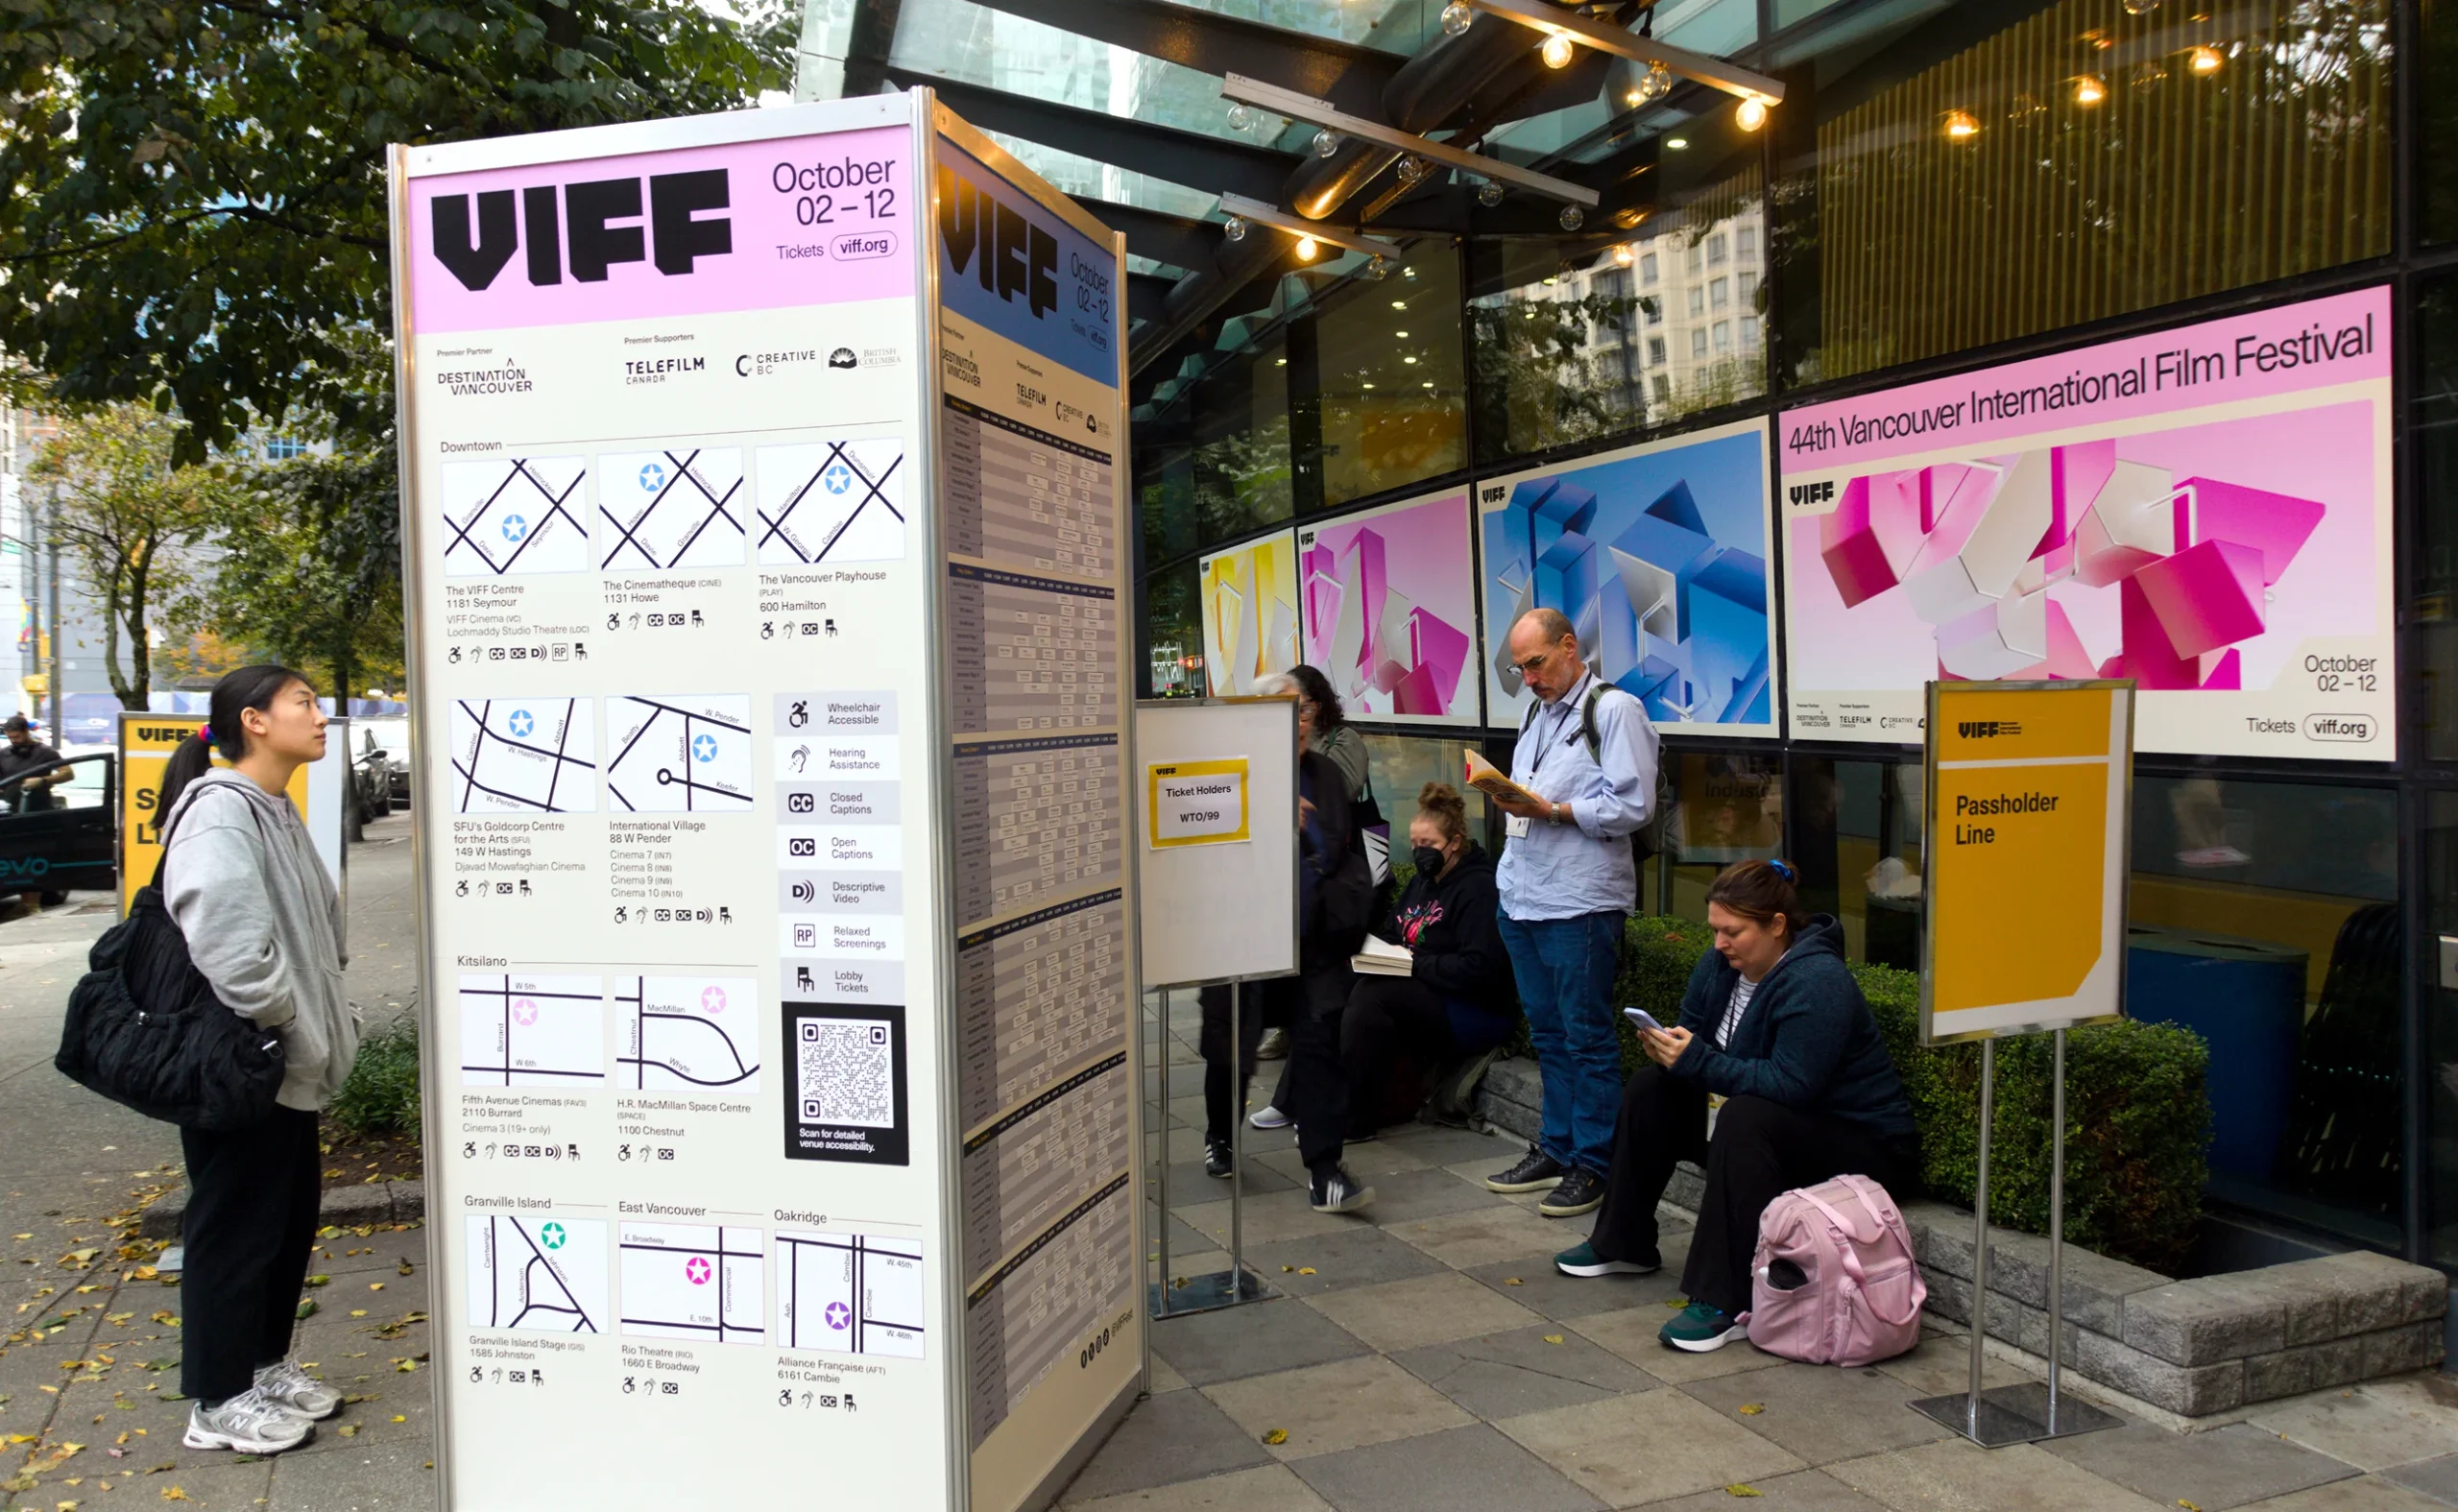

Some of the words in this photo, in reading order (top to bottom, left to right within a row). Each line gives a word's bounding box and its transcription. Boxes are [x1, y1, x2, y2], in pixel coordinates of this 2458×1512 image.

[772, 156, 896, 194] October
[431, 168, 733, 292] VIFF
[939, 161, 1058, 321] VIFF
[776, 243, 825, 259] Tickets
[839, 237, 889, 257] viff.org
[1071, 252, 1109, 296] October
[624, 335, 652, 345] Premier
[653, 332, 695, 343] Supporters
[757, 350, 815, 363] CREATIVE
[626, 358, 705, 374] TELEFILM
[757, 365, 773, 374] BC
[438, 369, 525, 384] DESTINATION
[626, 374, 666, 385] CANADA
[451, 381, 533, 396] VANCOUVER
[1789, 421, 1836, 455] 44th
[1840, 401, 1965, 445] Vancouver
[1971, 358, 2146, 424] International
[2155, 348, 2225, 393] Film
[2234, 314, 2374, 376] Festival
[441, 440, 502, 452] Downtown
[848, 450, 876, 480] Dunsmuir
[777, 485, 802, 514] Hamilton
[1482, 486, 1506, 503] VIFF
[1790, 480, 1835, 507] VIFF
[1300, 531, 1315, 546] VIFF
[759, 575, 778, 584] The
[780, 574, 832, 584] Vancouver
[835, 571, 886, 584] Playhouse
[446, 586, 465, 595] The
[467, 586, 489, 595] VIFF
[491, 585, 524, 594] Centre
[603, 581, 622, 590] The
[624, 579, 696, 589] Cinematheque
[446, 599, 470, 608] 1181
[472, 598, 517, 609] Seymour
[631, 593, 659, 602] Howe
[759, 602, 779, 612] 600
[782, 601, 826, 611] Hamilton
[446, 615, 468, 624] VIFF
[469, 614, 504, 623] Cinema
[447, 628, 499, 636] Lochmaddy
[501, 626, 531, 636] Studio
[533, 625, 567, 634] Theatre
[2303, 653, 2377, 673] October
[828, 702, 880, 714] Wheelchair
[828, 714, 879, 725] Accessible
[1959, 722, 1999, 738] VIFF
[2246, 717, 2296, 733] Tickets
[2313, 719, 2367, 737] viff.org
[829, 748, 866, 760] Hearing
[830, 758, 880, 770] Assistance
[1166, 788, 1194, 797] Ticket
[1196, 785, 1232, 795] Holders
[830, 792, 863, 804] Closed
[1956, 792, 2059, 816] Passholder
[831, 804, 872, 816] Captions
[1180, 811, 1219, 823] WTO/99
[454, 822, 482, 831] SFU's
[484, 822, 530, 832] Goldcorp
[531, 821, 565, 831] Centre
[609, 821, 670, 830] International
[673, 821, 706, 832] Village
[454, 835, 468, 844] for
[470, 834, 486, 844] the
[488, 834, 509, 843] Arts
[610, 834, 622, 843] 88
[624, 833, 634, 843] W
[637, 833, 671, 843] Pender
[1956, 825, 1995, 845] Line
[831, 837, 856, 849] Open
[455, 847, 472, 856] 149
[476, 847, 486, 856] W
[488, 847, 531, 858] Hastings
[610, 851, 645, 859] Cinema
[646, 851, 652, 859] 7
[831, 849, 873, 861] Captions
[455, 862, 486, 873] Djavad
[488, 862, 548, 873] Mowafaghian
[551, 861, 586, 872] Cinema
[611, 862, 645, 872] Cinema
[647, 863, 653, 872] 8
[611, 876, 645, 885] Cinema
[647, 876, 653, 884] 9
[611, 888, 645, 897] Cinema
[832, 880, 885, 895] Descriptive
[833, 893, 860, 903] Video
[833, 926, 870, 938] Relaxed
[833, 938, 886, 951] Screenings
[457, 955, 507, 968] Kitsilano
[834, 971, 863, 984] Lobby
[834, 982, 869, 993] Tickets
[647, 1004, 686, 1013] MacMillan
[462, 1095, 483, 1104] Fifth
[485, 1096, 519, 1105] Avenue
[521, 1096, 562, 1106] Cinemas
[616, 1099, 636, 1108] H.R.
[638, 1100, 687, 1110] MacMillan
[688, 1102, 717, 1112] Space
[719, 1102, 751, 1113] Centre
[462, 1108, 486, 1116] 2110
[488, 1109, 522, 1117] Burrard
[463, 1123, 497, 1133] Cinema
[499, 1124, 505, 1133] 3
[507, 1124, 526, 1134] (19+
[529, 1125, 551, 1136] only)
[618, 1126, 641, 1135] 1100
[642, 1126, 685, 1137] Chestnut
[799, 1128, 820, 1138] Scan
[821, 1129, 832, 1138] for
[833, 1130, 865, 1140] detailed
[825, 1141, 875, 1153] accessibility.
[465, 1195, 514, 1209] Granville
[517, 1197, 551, 1209] Island
[619, 1202, 642, 1213] East
[644, 1203, 706, 1216] Vancouver
[774, 1210, 827, 1225] Oakridge
[469, 1335, 509, 1346] Granville
[511, 1338, 538, 1348] Island
[540, 1339, 566, 1351] Stage
[470, 1349, 493, 1357] 1585
[495, 1350, 536, 1359] Johnston
[622, 1345, 637, 1355] Rio
[639, 1346, 673, 1357] Theatre
[622, 1358, 645, 1368] 1660
[647, 1359, 653, 1368] E
[655, 1359, 700, 1374] Broadway
[778, 1356, 815, 1368] Alliance
[818, 1359, 864, 1375] Française
[778, 1370, 801, 1380] 6161
[804, 1372, 840, 1382] Cambie
